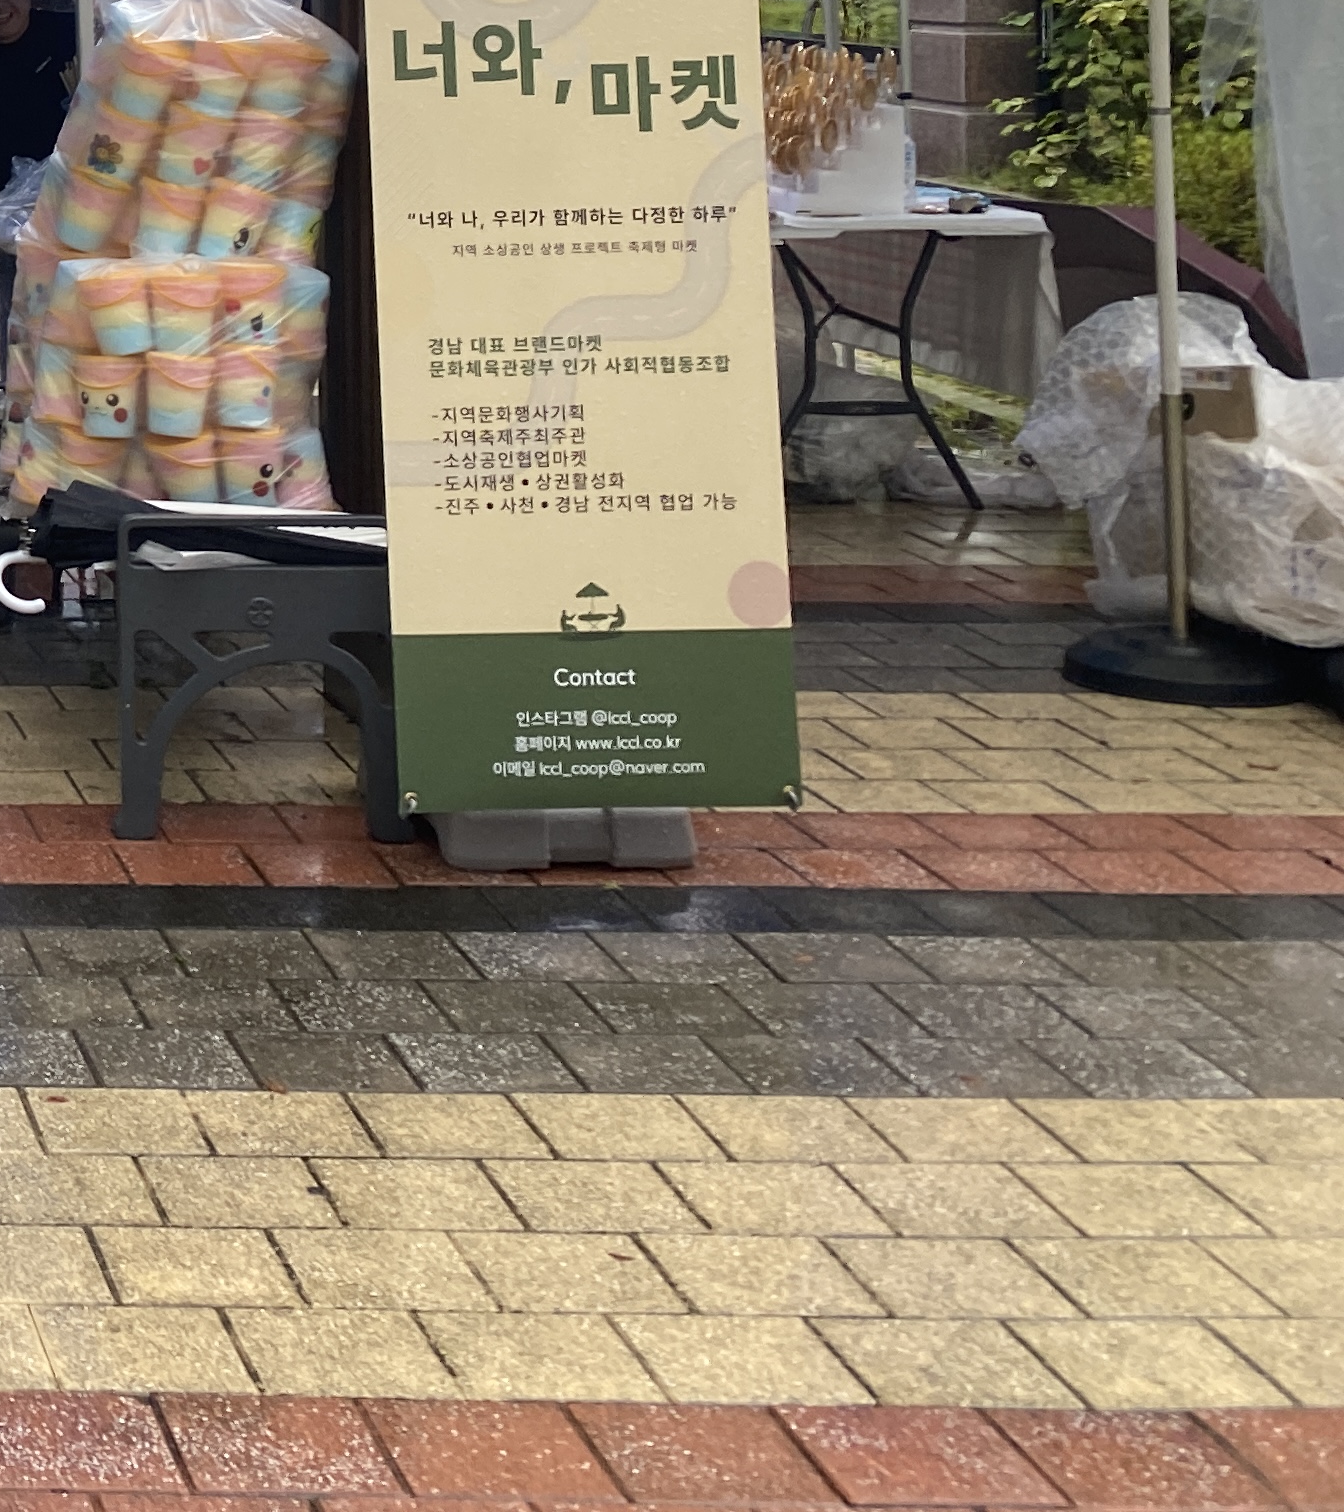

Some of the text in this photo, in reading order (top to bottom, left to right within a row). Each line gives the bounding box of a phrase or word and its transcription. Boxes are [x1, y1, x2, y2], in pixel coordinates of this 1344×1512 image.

[392, 19, 740, 132] 너와, 마켓
[462, 210, 484, 230] 나,
[492, 209, 545, 228] 우리가
[553, 207, 623, 226] 함께하는
[632, 206, 685, 225] 다정한
[452, 244, 477, 257] 지역
[483, 243, 534, 256] 소상공인
[540, 243, 565, 256] 상생
[571, 241, 622, 254] 프로젝트
[672, 240, 698, 253] 마켓
[428, 335, 602, 355] 경남 대표 브랜드마켓
[429, 355, 730, 378] 문화체육관광부 인가 사회적협동조합
[536, 472, 625, 491] 상권활성화
[500, 497, 534, 515] 사천
[555, 495, 589, 514] 경남
[599, 494, 650, 513] 전지역
[660, 493, 694, 512] 협업
[703, 492, 737, 511] 가능
[553, 668, 637, 687] Contact
[516, 710, 678, 728] 인스타그램 @lccl_coop
[514, 735, 681, 752] 홈페이지 www.lccl.co.kr
[493, 759, 706, 778] 이메일 lccl_coop@naver.com
